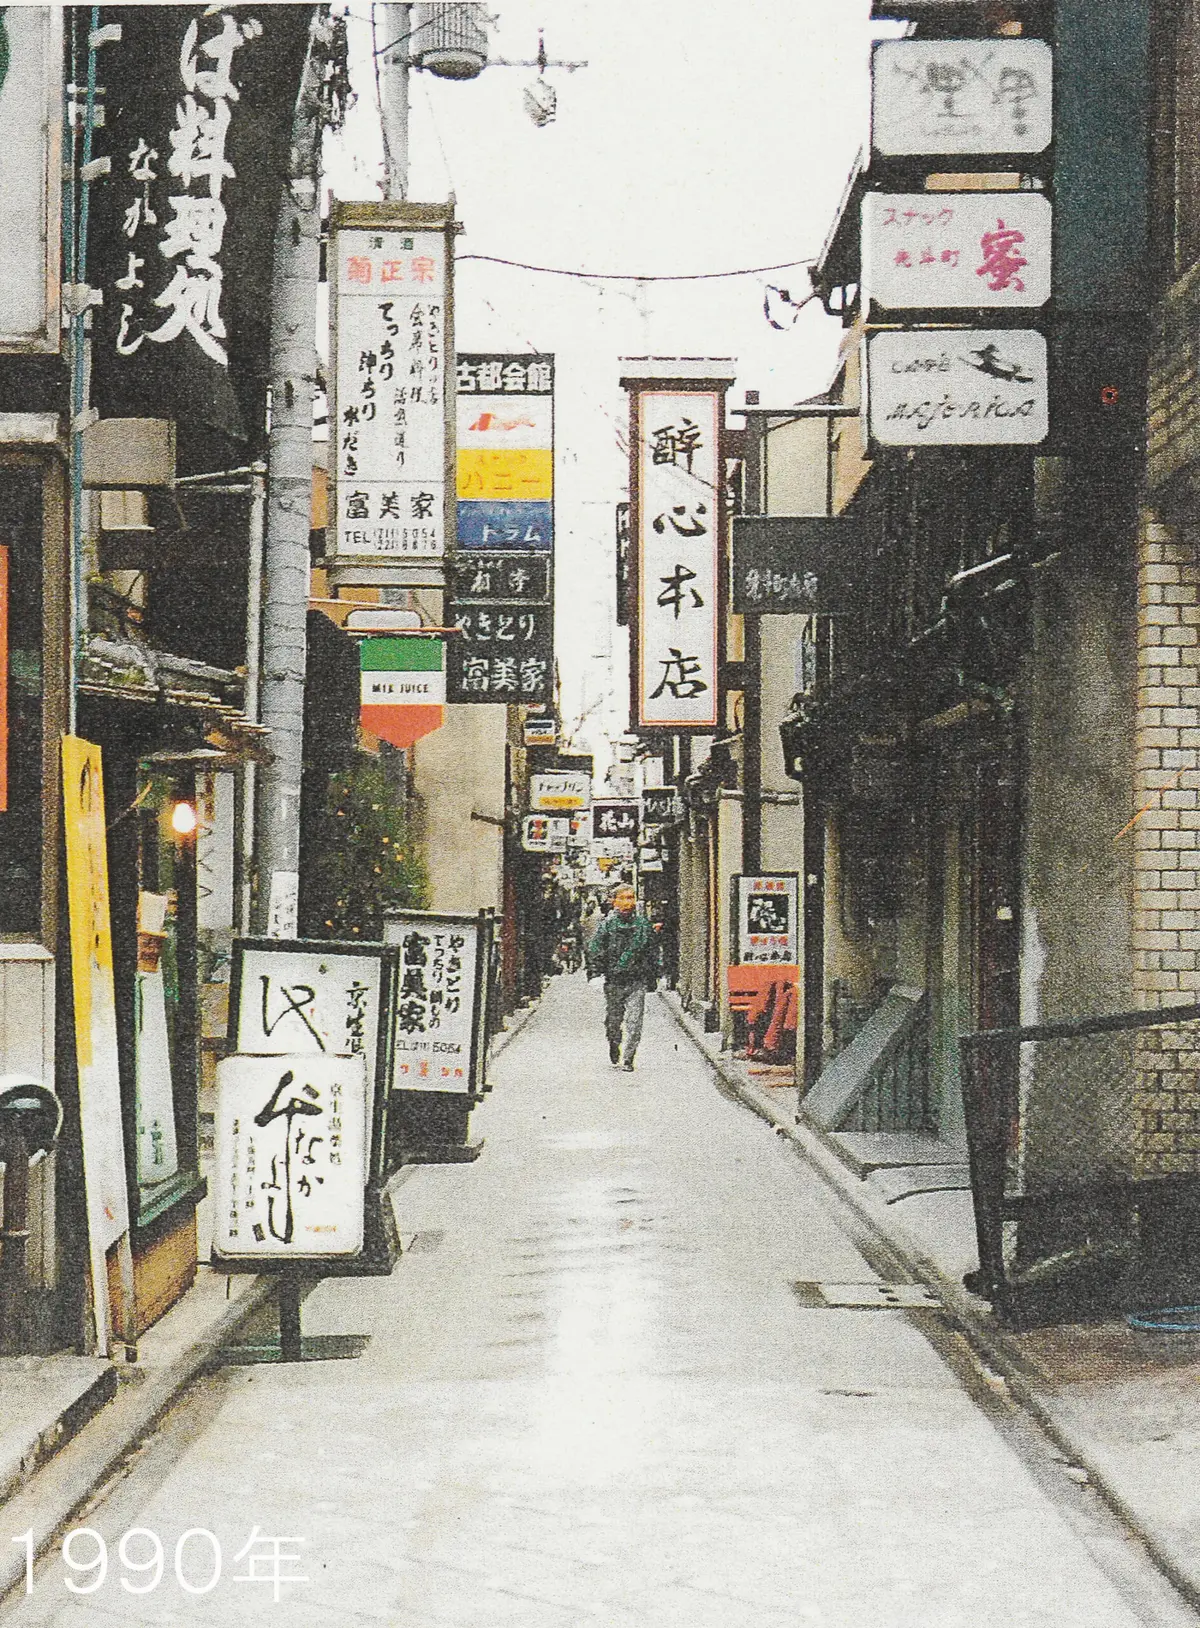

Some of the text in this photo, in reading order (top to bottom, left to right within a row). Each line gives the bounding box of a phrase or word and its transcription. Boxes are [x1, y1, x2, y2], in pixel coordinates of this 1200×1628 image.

[883, 208, 953, 226] スナック
[116, 138, 159, 355] なかよし
[369, 236, 414, 251] 清酒
[347, 256, 436, 285] 菊正宗
[378, 302, 399, 381] てっちり
[456, 361, 551, 391] 古都会館
[342, 405, 360, 477] 水だき
[345, 490, 435, 520] 富美家
[345, 531, 371, 544] TEL
[455, 612, 535, 641] やきとり
[399, 684, 429, 693] JUICE
[462, 656, 547, 691] 富美家
[445, 934, 465, 1014] やきとり
